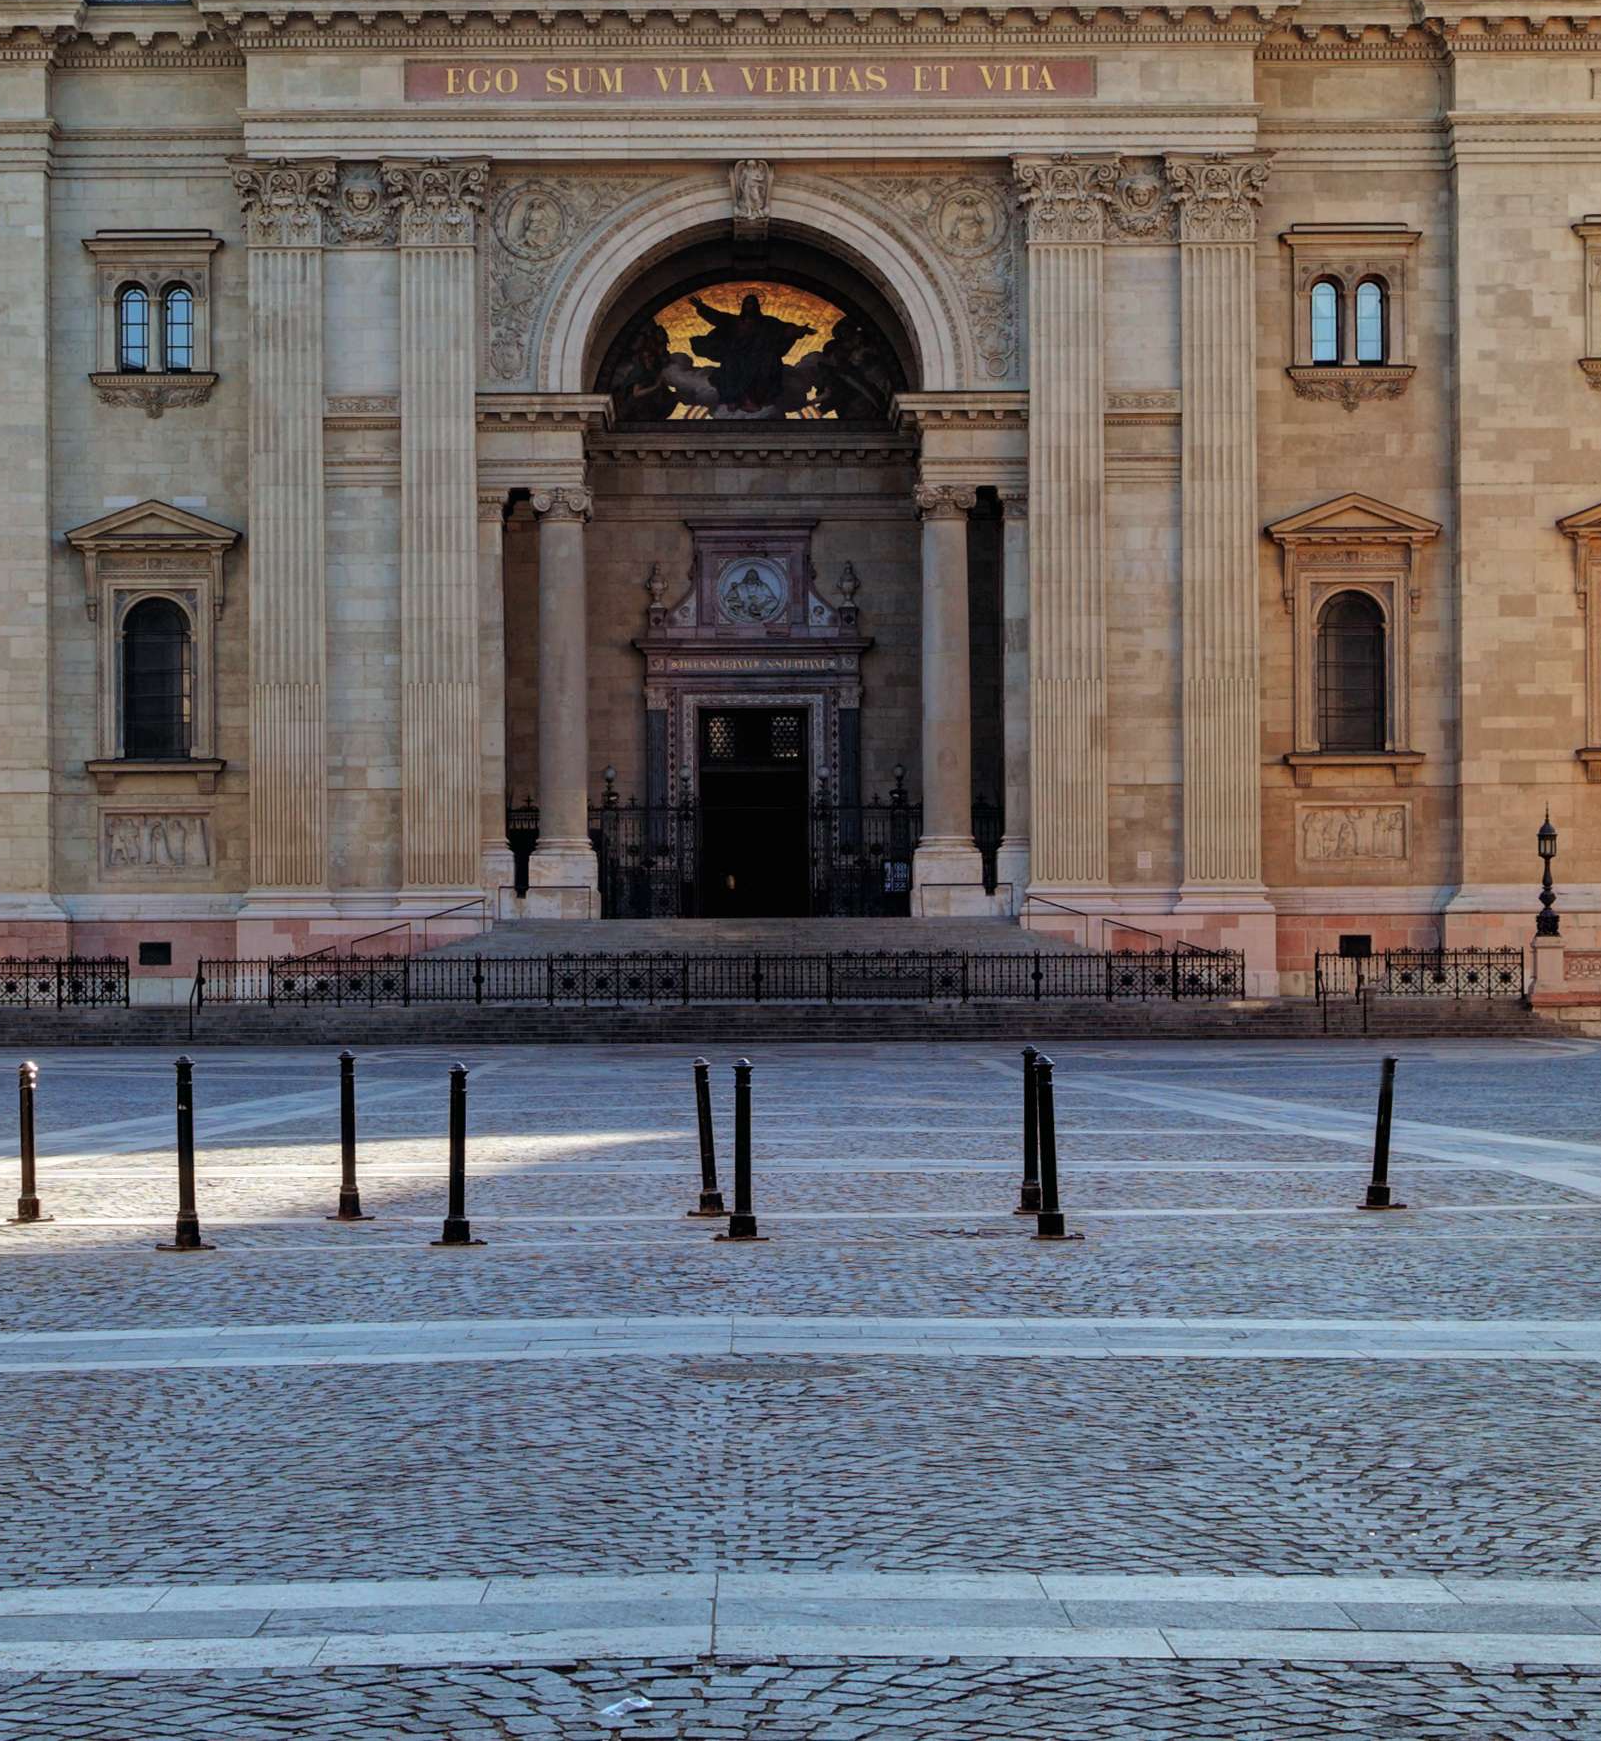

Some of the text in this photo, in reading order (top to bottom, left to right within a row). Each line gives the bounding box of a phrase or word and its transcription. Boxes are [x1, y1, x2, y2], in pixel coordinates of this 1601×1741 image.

[446, 65, 1056, 93] EGO SUM VIA VERITAS ET VITA
